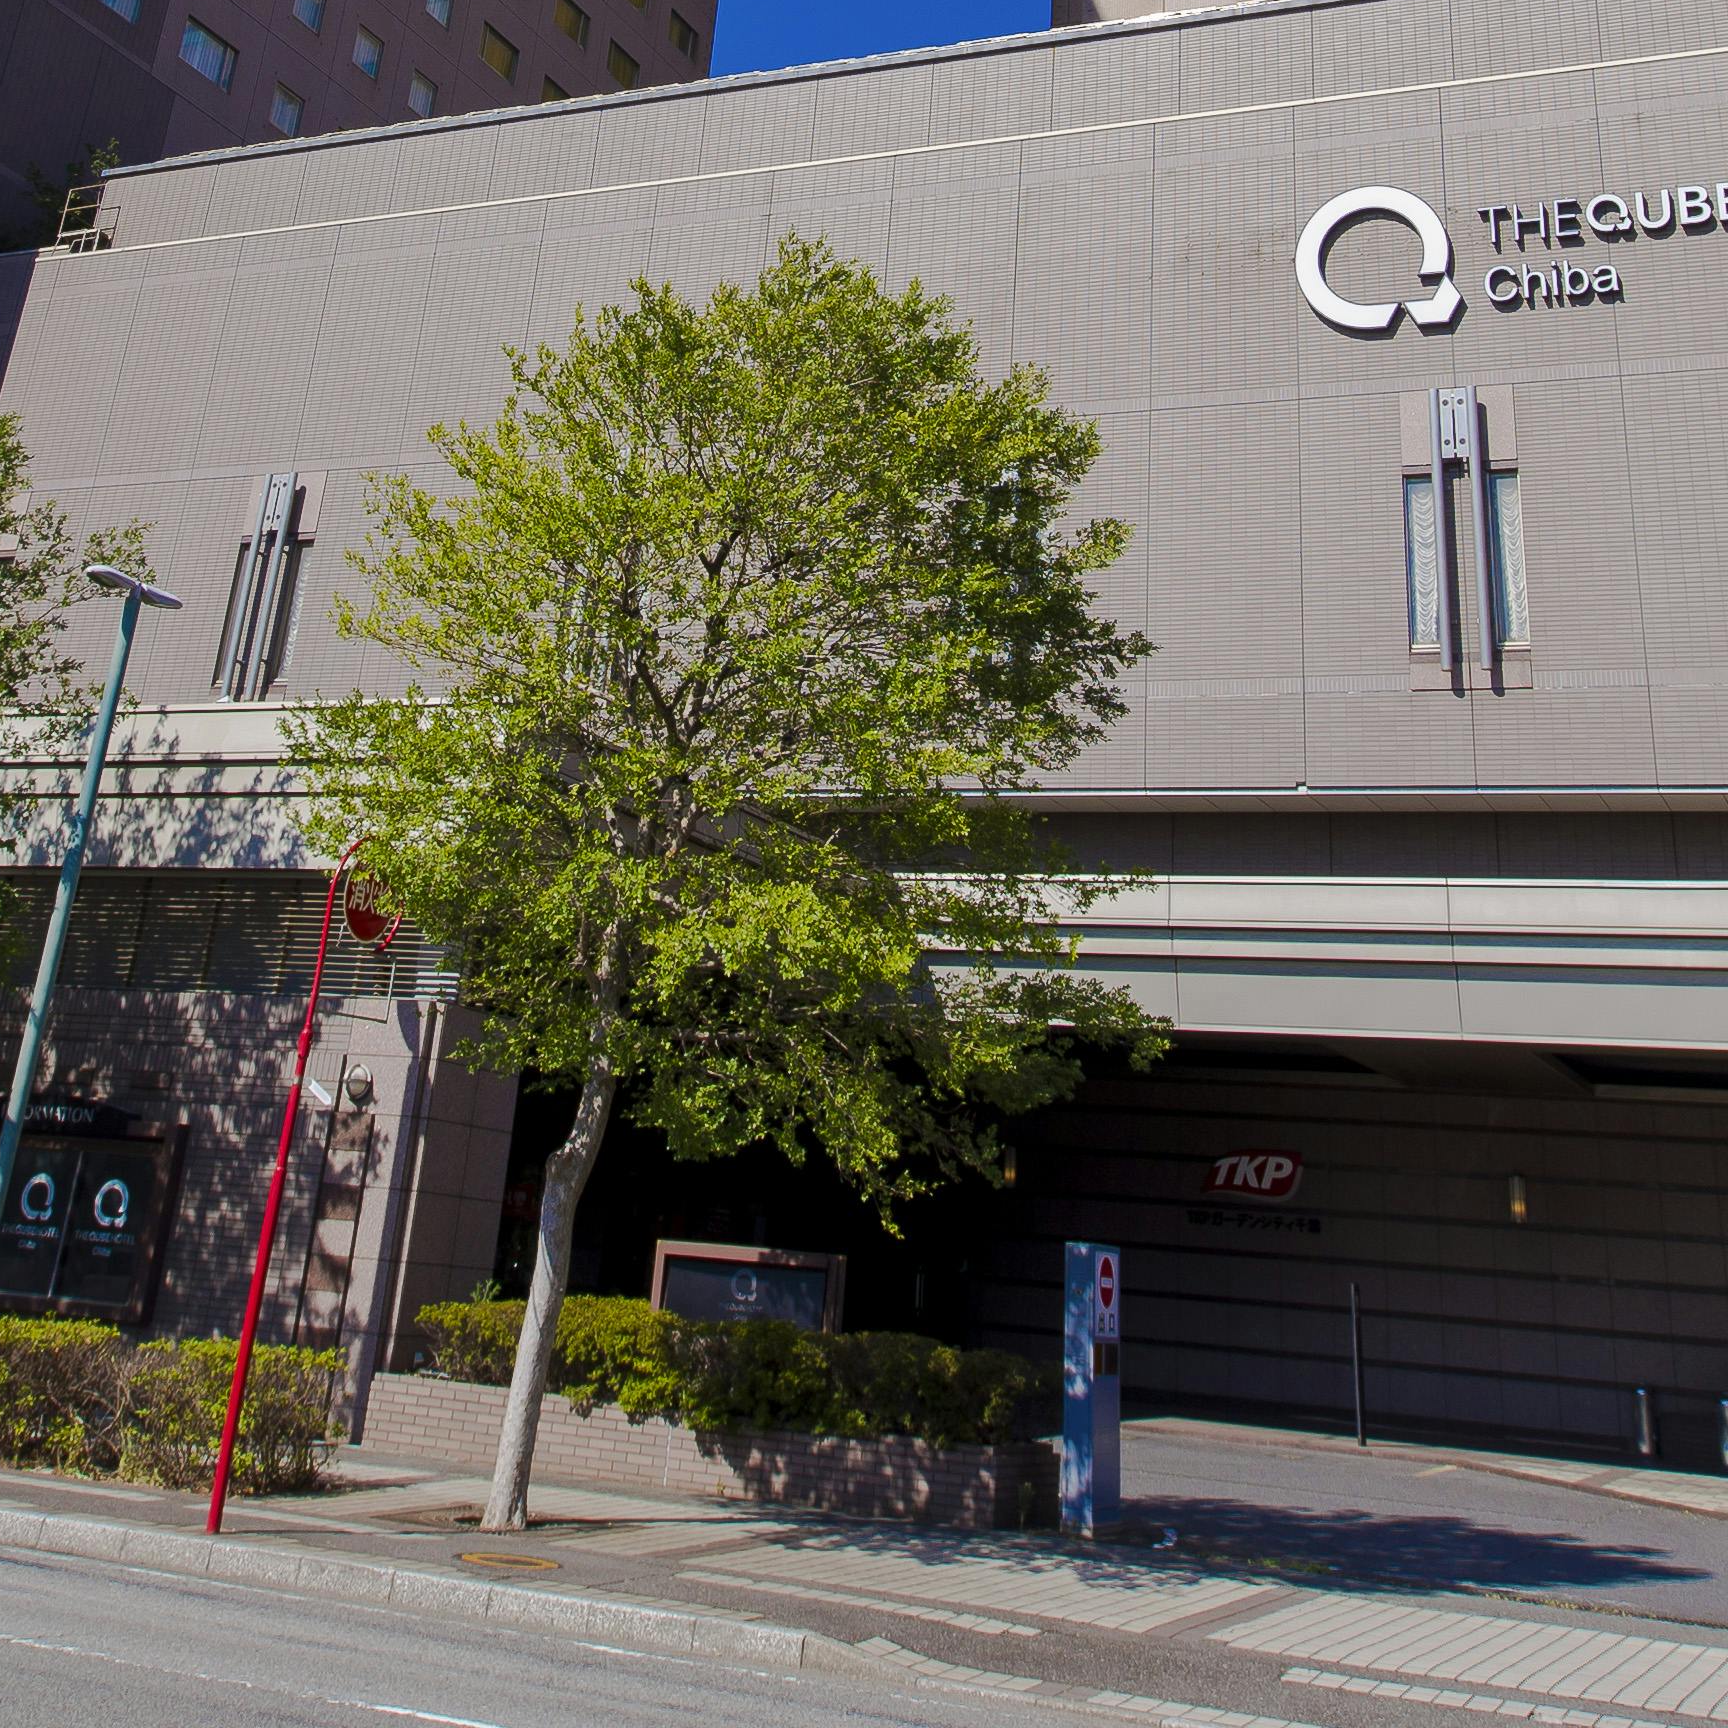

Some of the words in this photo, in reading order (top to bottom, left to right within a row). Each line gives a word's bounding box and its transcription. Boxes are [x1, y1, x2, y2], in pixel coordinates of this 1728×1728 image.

[1483, 261, 1620, 303] Chiba
[348, 875, 390, 914] 消火
[1, 1103, 96, 1123] ORMATION
[1214, 1155, 1293, 1189] TKP
